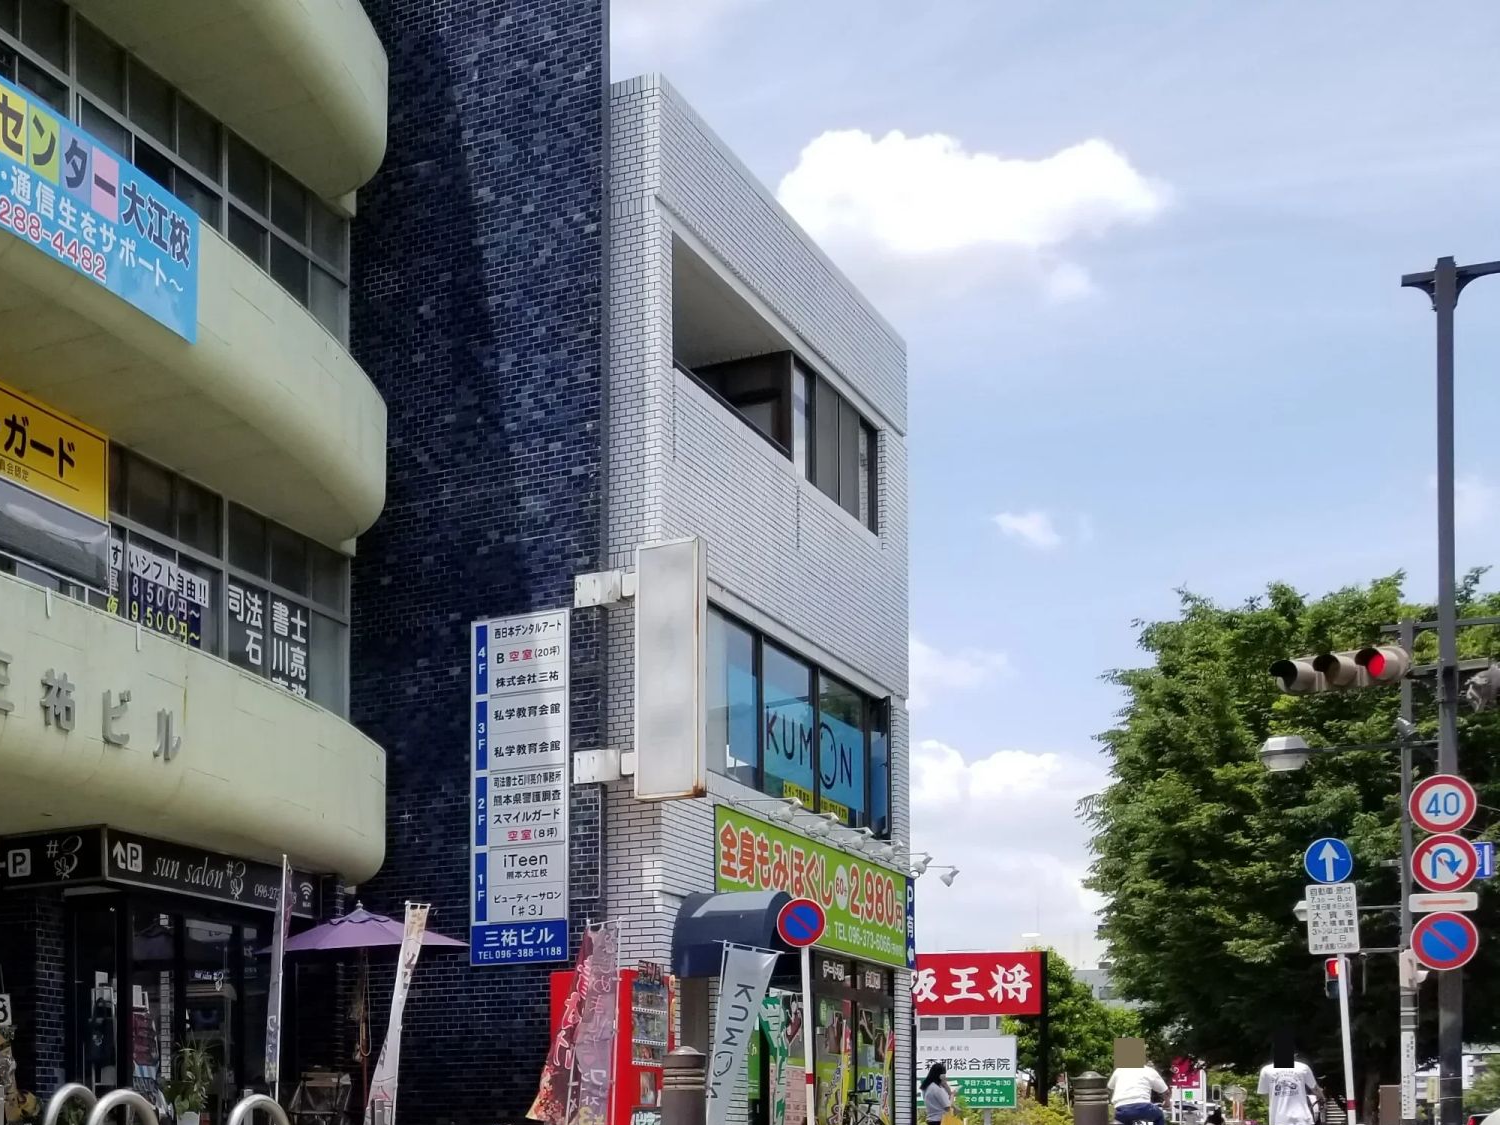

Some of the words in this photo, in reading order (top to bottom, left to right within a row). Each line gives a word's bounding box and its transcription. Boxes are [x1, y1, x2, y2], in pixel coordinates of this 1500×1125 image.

[122, 180, 190, 269] 大江校
[228, 585, 307, 643] 司法書士
[494, 619, 562, 639] 西日本デンタルアート
[477, 646, 486, 675] 4F
[496, 652, 505, 664] B
[496, 670, 559, 688] 株式会社三祐
[493, 702, 561, 721] 私学教育会館
[477, 722, 486, 750] 3F
[493, 740, 561, 758] 私学教育会館
[765, 706, 852, 790] KUMON
[477, 798, 486, 826] 2F
[1425, 792, 1460, 817] 40
[493, 808, 561, 825] スマイルガード
[503, 854, 548, 868] iTeen
[719, 821, 833, 910] 全身もみほぐし
[153, 857, 181, 880] sun
[184, 857, 224, 889] salon
[506, 869, 547, 880] 熊本大江校
[477, 874, 485, 902] 1F
[494, 891, 562, 904] ビューティーサロン
[483, 926, 555, 947] 三祐ビル
